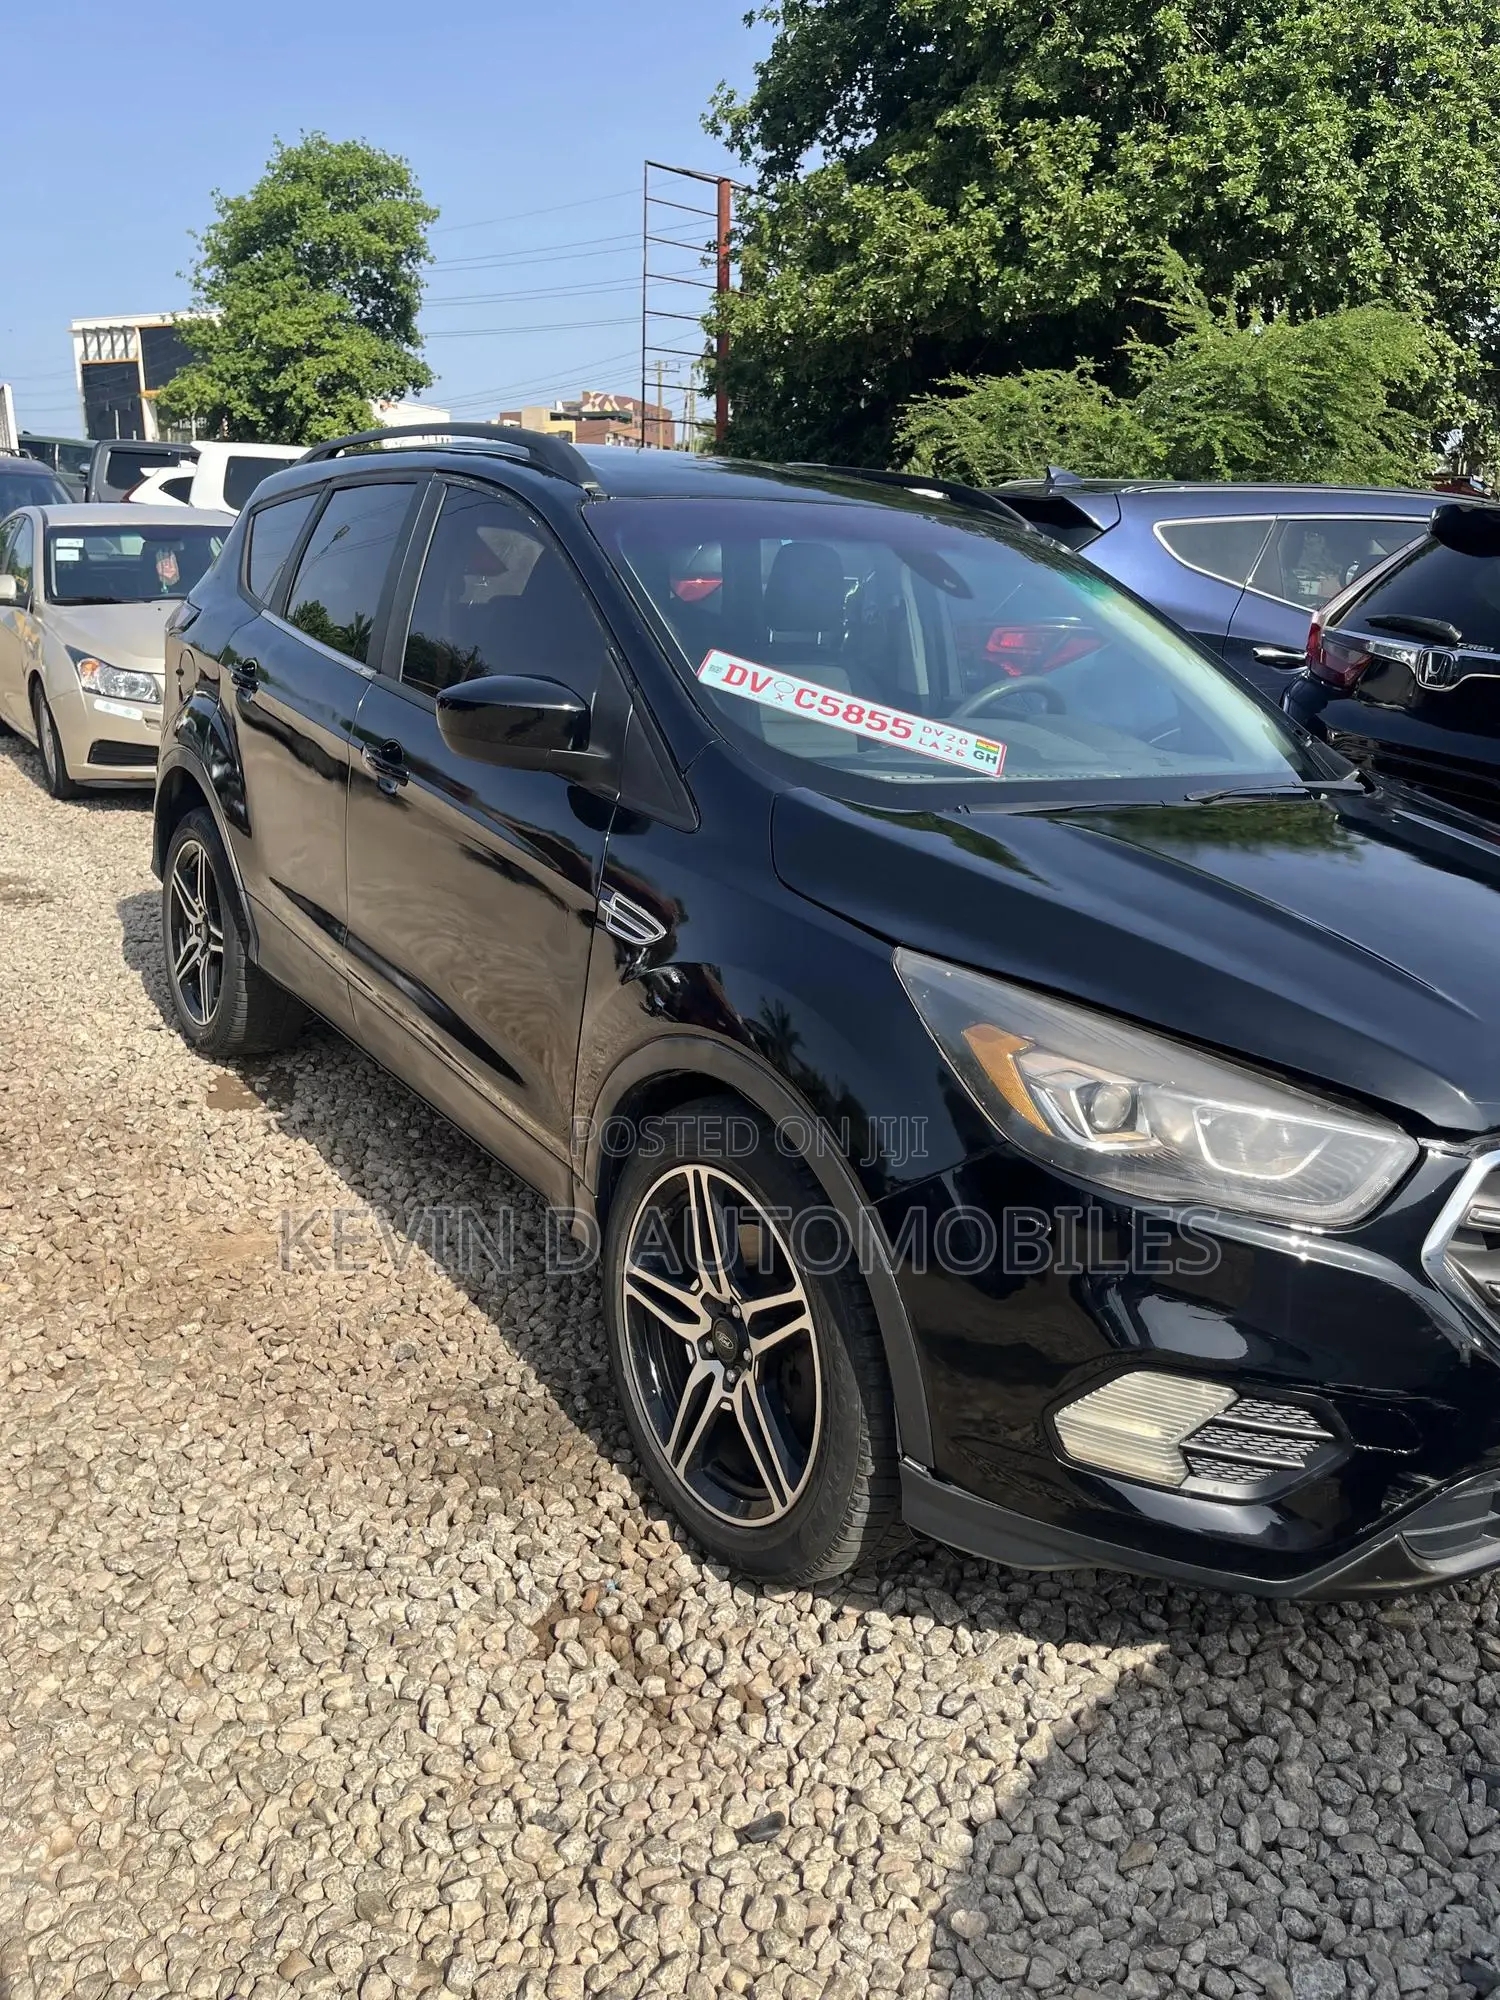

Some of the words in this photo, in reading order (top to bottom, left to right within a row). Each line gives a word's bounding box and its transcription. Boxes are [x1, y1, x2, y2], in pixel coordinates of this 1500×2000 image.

[722, 664, 772, 692] DV
[794, 688, 914, 739] C5855
[973, 750, 998, 764] GH
